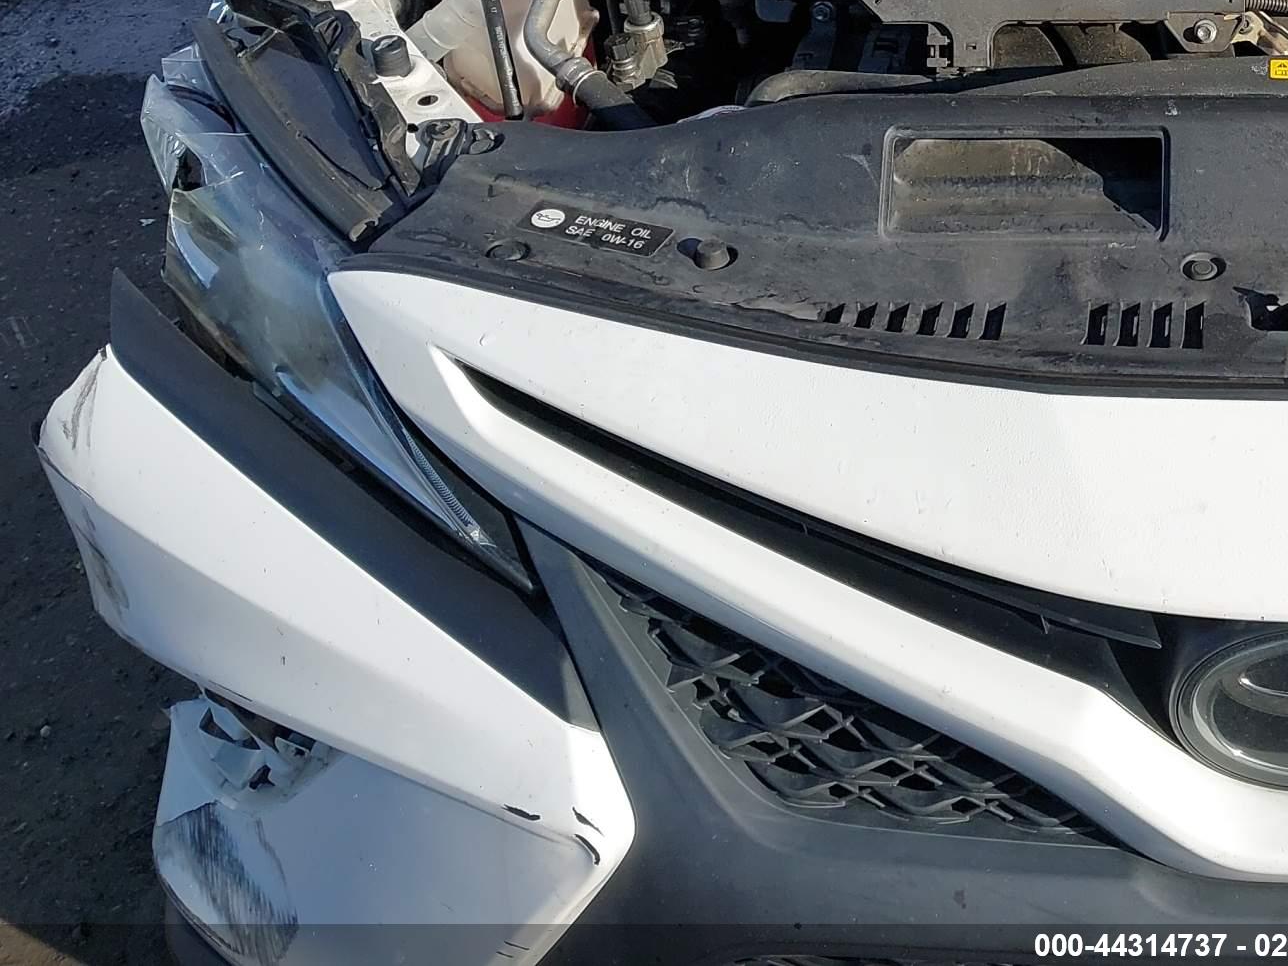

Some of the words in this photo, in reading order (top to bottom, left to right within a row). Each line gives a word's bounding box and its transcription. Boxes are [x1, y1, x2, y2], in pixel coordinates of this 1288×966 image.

[565, 225, 596, 237] SAE
[600, 233, 646, 250] 0W-16
[575, 215, 626, 233] ENGINE
[630, 227, 652, 240] OIL
